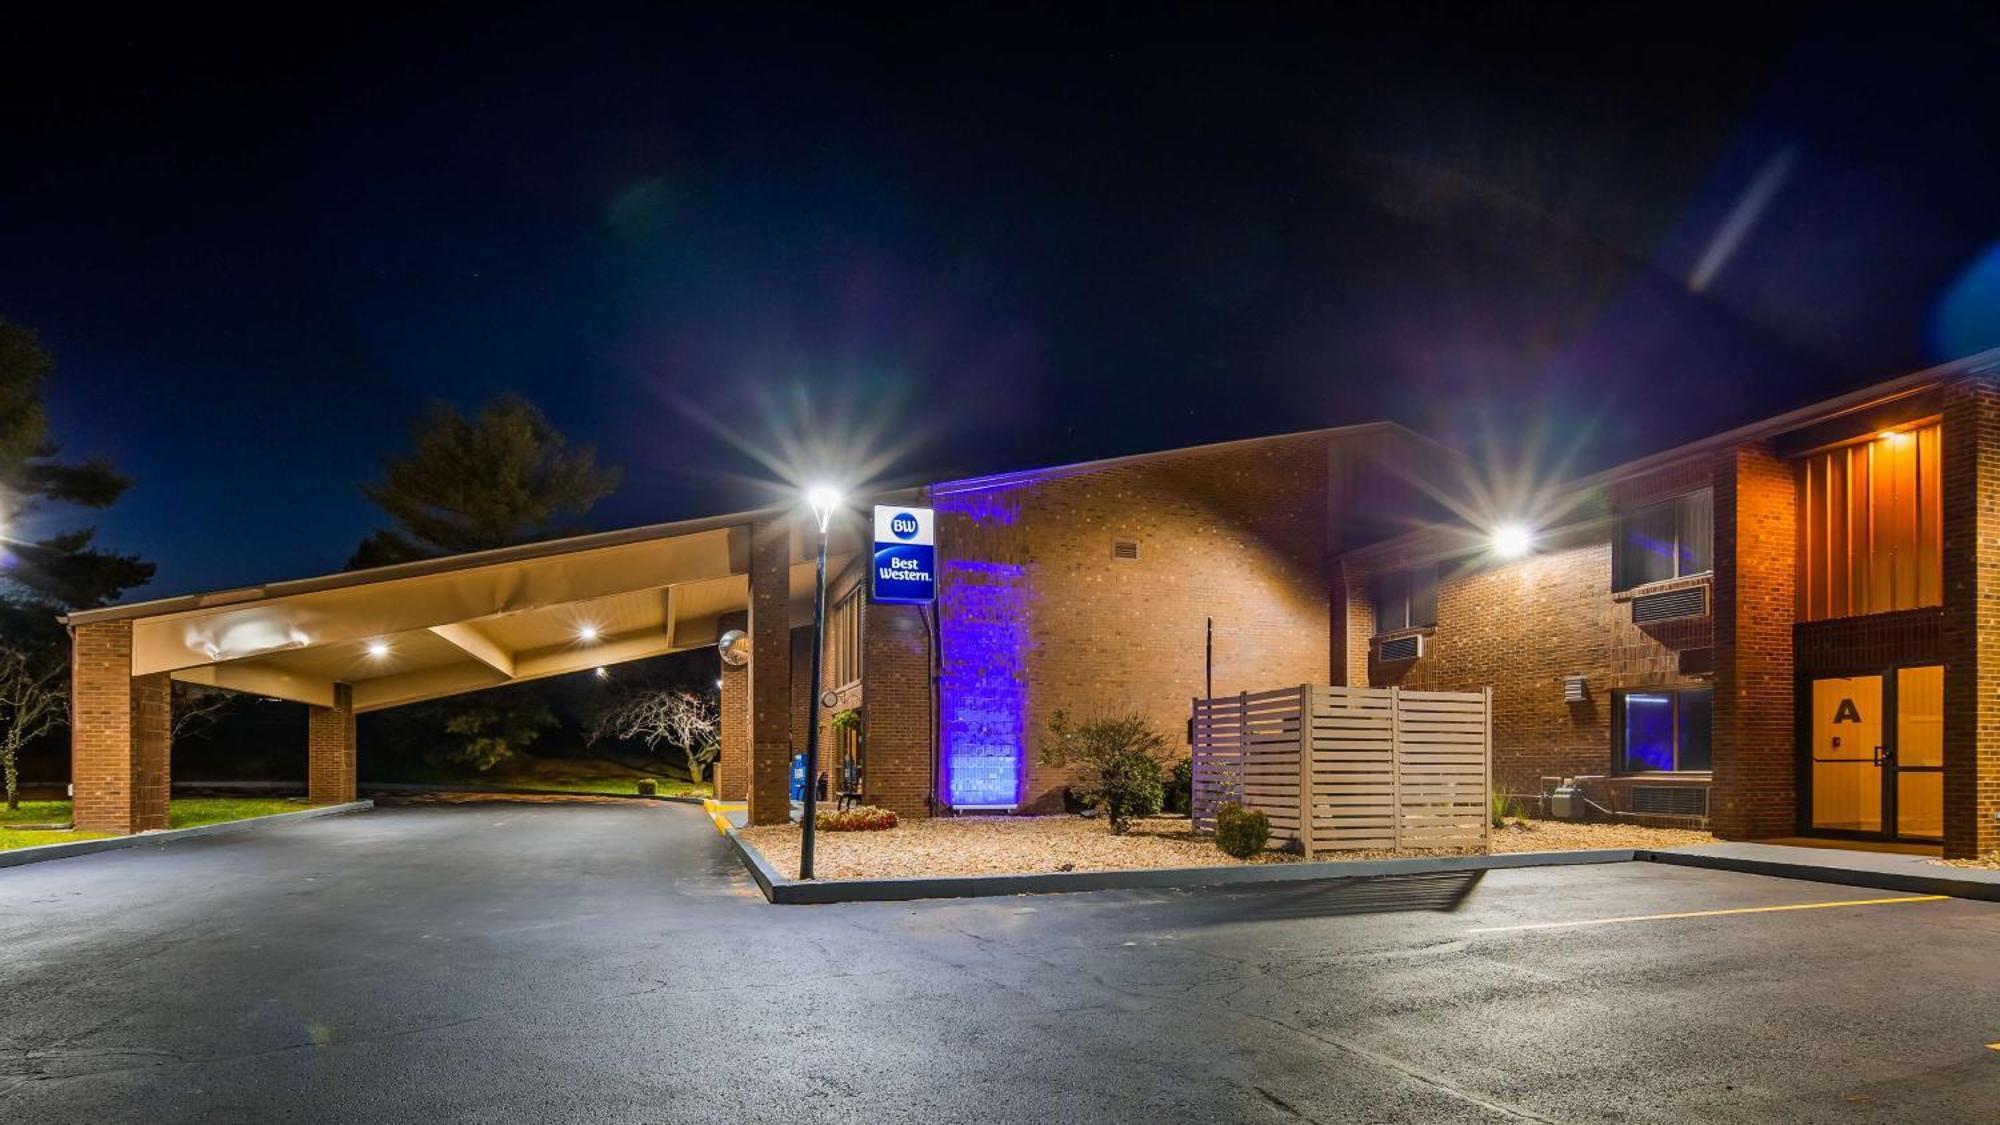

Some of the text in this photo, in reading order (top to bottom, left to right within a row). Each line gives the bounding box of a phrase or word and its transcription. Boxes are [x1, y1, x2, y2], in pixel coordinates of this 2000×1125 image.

[893, 519, 916, 533] BW
[891, 557, 919, 570] Best
[1832, 698, 1862, 723] A
